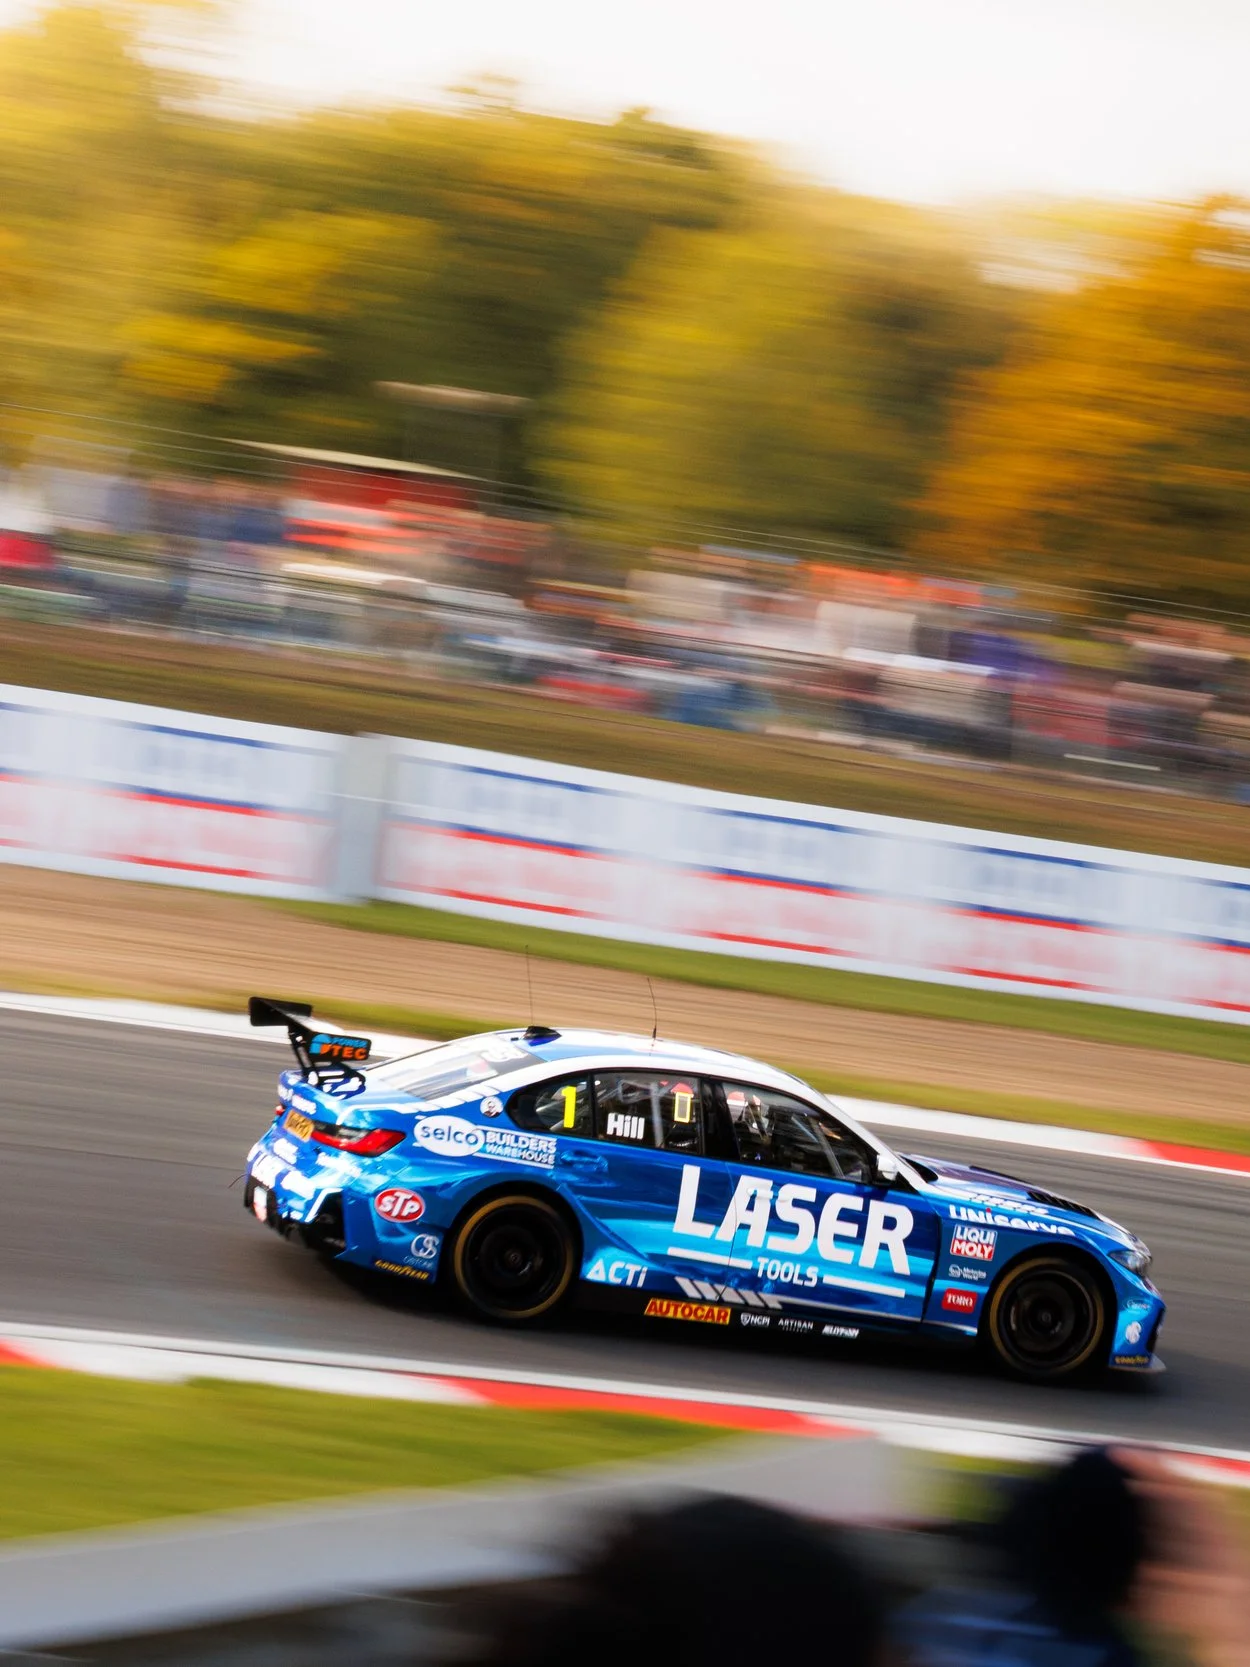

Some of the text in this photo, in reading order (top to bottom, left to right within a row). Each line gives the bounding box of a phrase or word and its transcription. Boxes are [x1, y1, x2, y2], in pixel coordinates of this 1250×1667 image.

[331, 1044, 367, 1060] TEC
[561, 1085, 577, 1129] 1
[420, 1124, 479, 1146] selco
[606, 1112, 645, 1140] Hill
[486, 1131, 557, 1154] BUILDERS
[485, 1144, 556, 1165] WAREHOUSE
[378, 1191, 421, 1218] STP
[673, 1163, 914, 1276] LASER
[955, 1226, 996, 1244] LIQUI
[952, 1240, 993, 1259] MOLY
[375, 1259, 429, 1280] GOODYEAR
[756, 1256, 818, 1288] TOOLS
[946, 1292, 973, 1307] TORO
[647, 1300, 730, 1323] AUTOCAR
